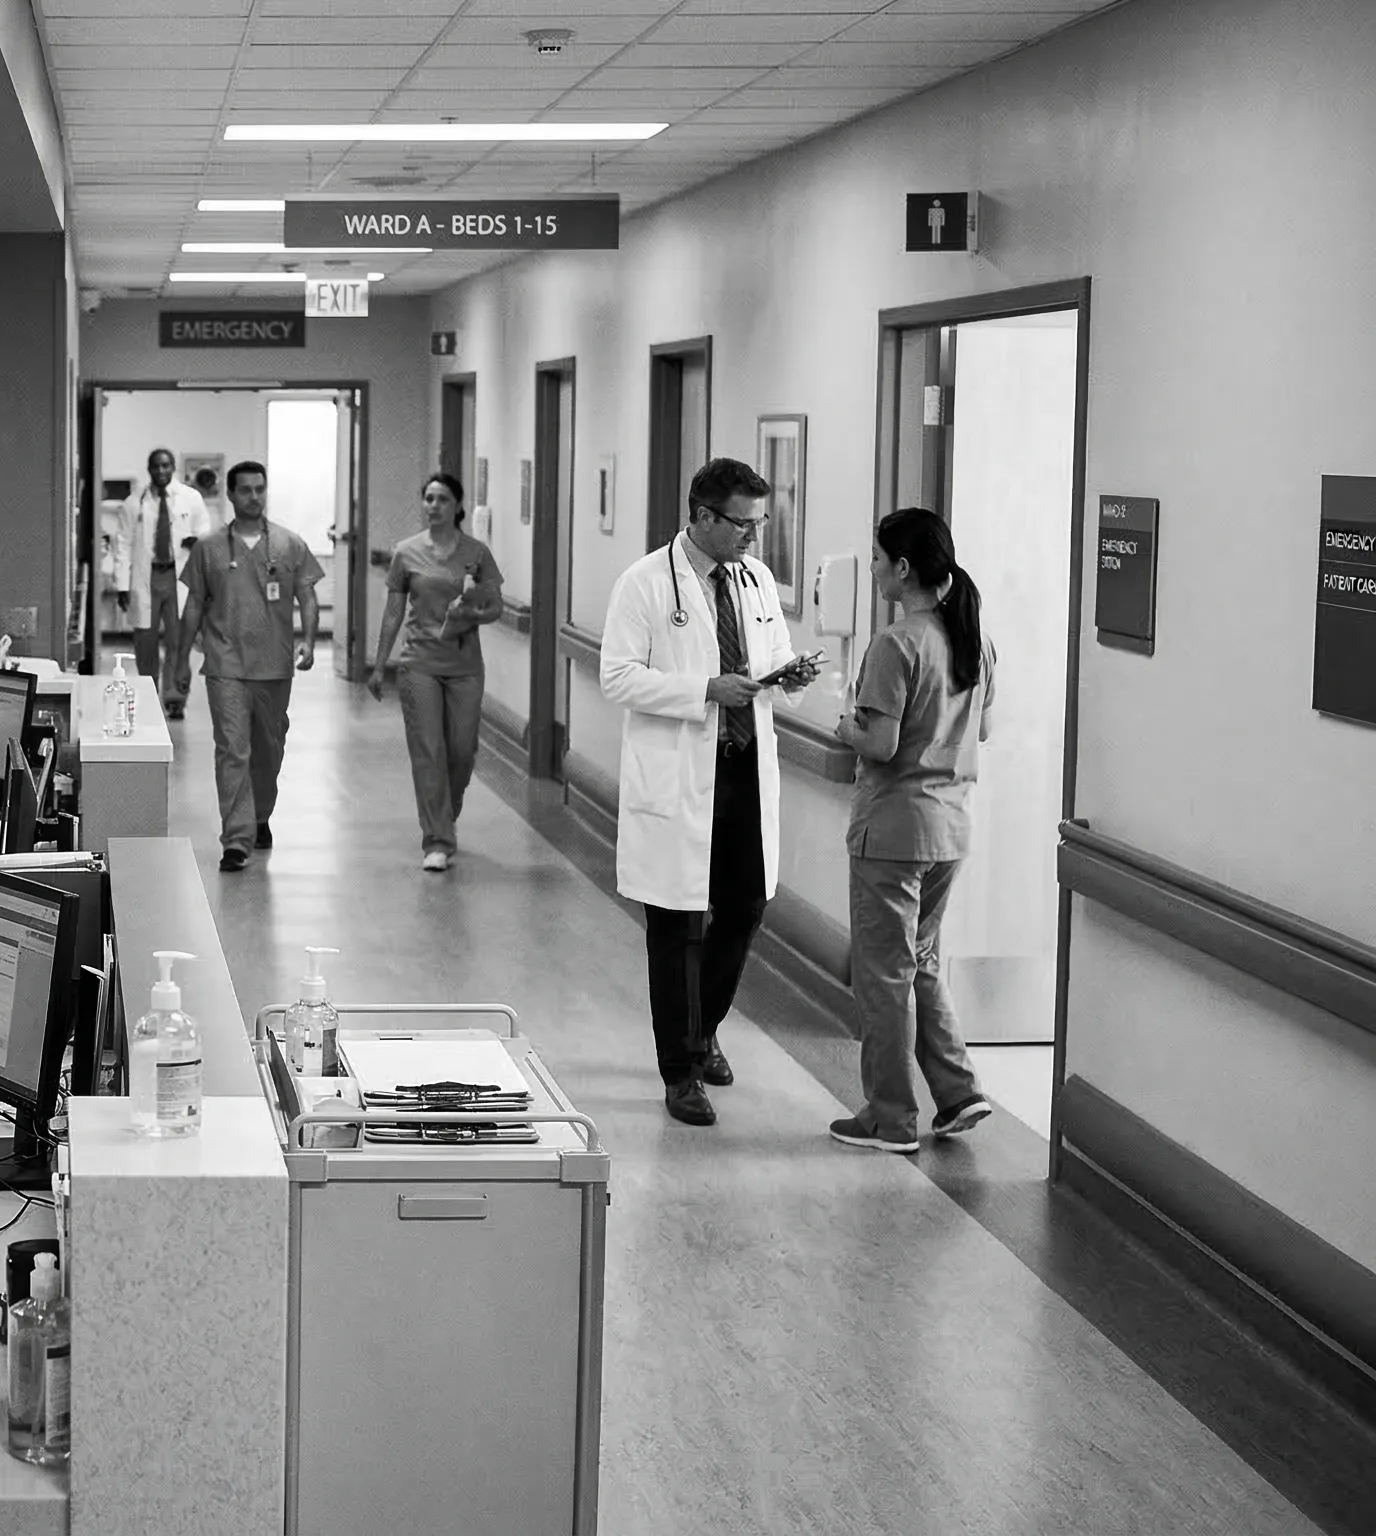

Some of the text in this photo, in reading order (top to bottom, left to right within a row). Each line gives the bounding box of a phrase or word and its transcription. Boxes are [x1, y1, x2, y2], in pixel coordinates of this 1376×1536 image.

[344, 214, 411, 235] WARD
[415, 214, 432, 235] A
[451, 214, 507, 235] BEDS
[514, 214, 557, 235] 1-15
[316, 284, 360, 312] EXIT
[171, 319, 294, 341] EMERGENCY
